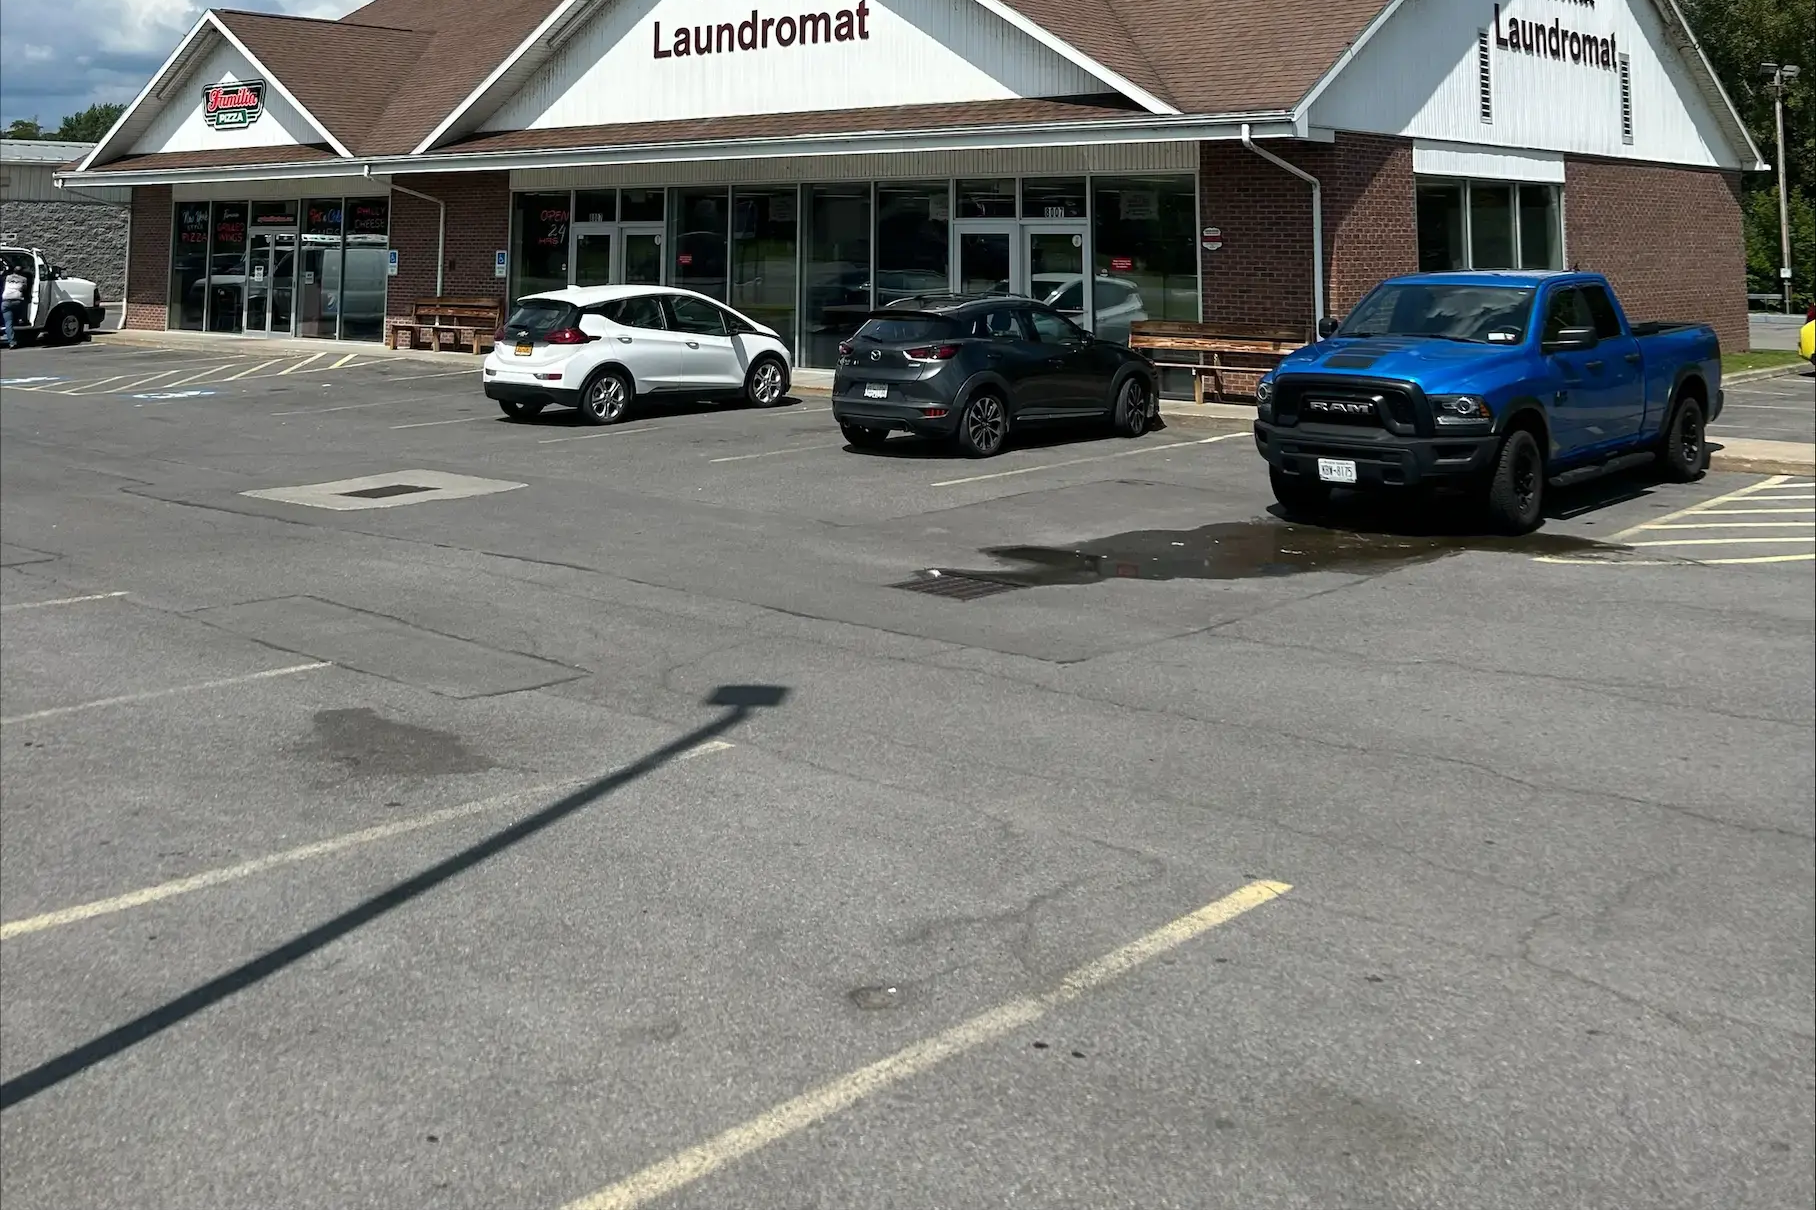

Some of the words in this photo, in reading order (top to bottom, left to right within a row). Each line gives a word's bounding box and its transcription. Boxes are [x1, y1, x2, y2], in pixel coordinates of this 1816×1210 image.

[1494, 3, 1618, 71] Laundromat
[208, 87, 258, 112] Familia
[219, 112, 244, 123] PIZZA
[541, 210, 569, 222] OPEN
[1044, 206, 1065, 219] 8007
[181, 232, 209, 243] PIZZA
[548, 223, 566, 244] 24
[1309, 401, 1370, 413] RAM
